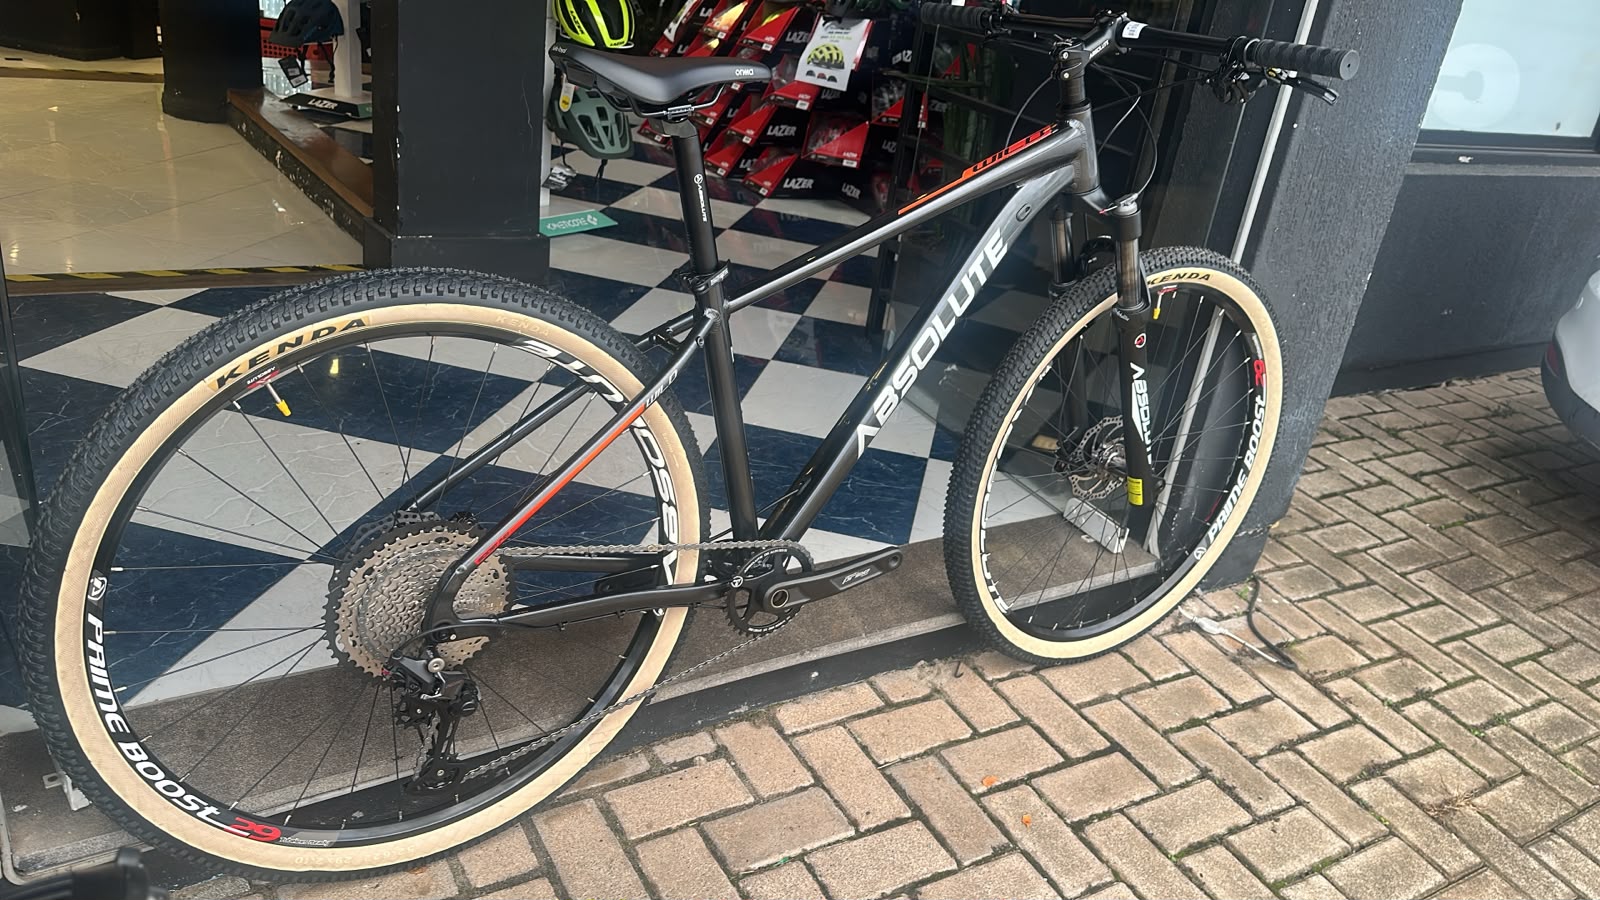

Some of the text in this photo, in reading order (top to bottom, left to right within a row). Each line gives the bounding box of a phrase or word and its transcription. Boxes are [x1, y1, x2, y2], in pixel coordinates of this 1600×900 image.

[307, 98, 339, 110] LAZER
[766, 124, 797, 137] LAZER
[783, 178, 814, 189] LAZER
[697, 184, 708, 222] ABSOLUTE
[215, 317, 367, 390] KENDA
[857, 228, 1008, 459] ABSOLUTE
[87, 612, 131, 734] PRIME
[224, 816, 282, 842] 29
